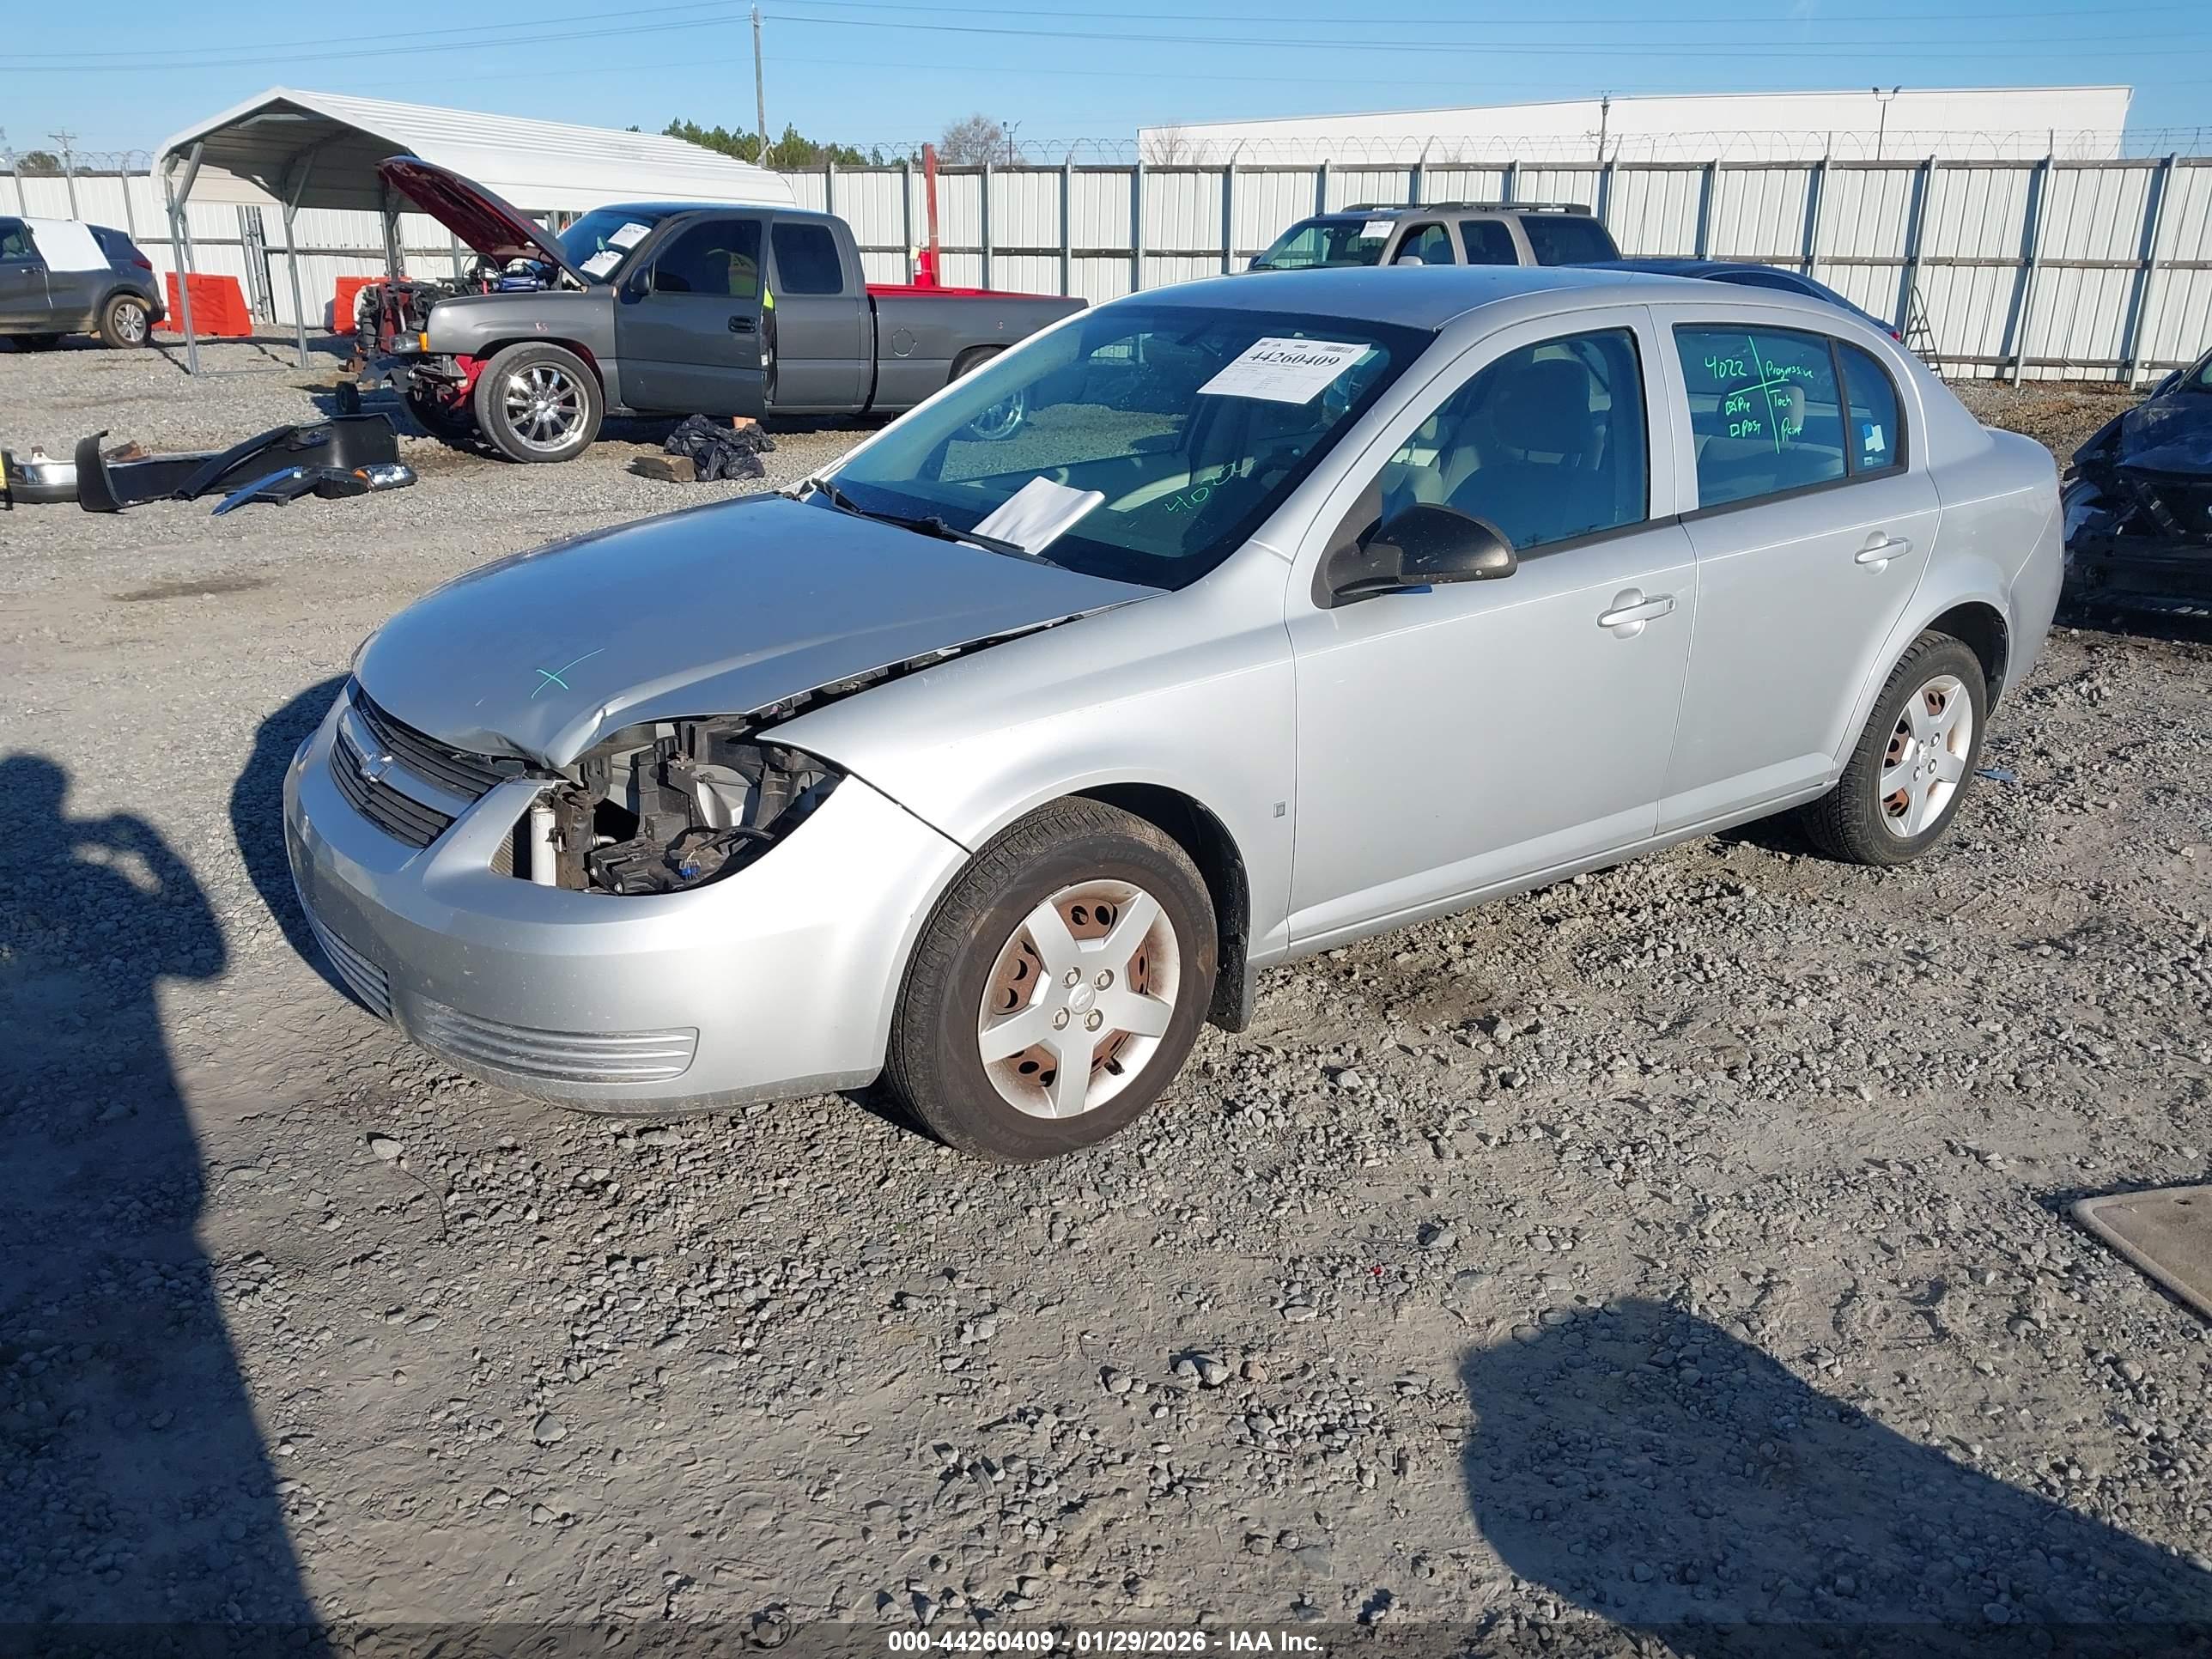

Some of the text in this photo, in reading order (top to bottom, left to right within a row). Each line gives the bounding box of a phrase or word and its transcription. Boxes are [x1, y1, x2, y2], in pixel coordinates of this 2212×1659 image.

[1249, 350, 1340, 368] 44260409
[1705, 356, 1814, 380] 4022 Progressive
